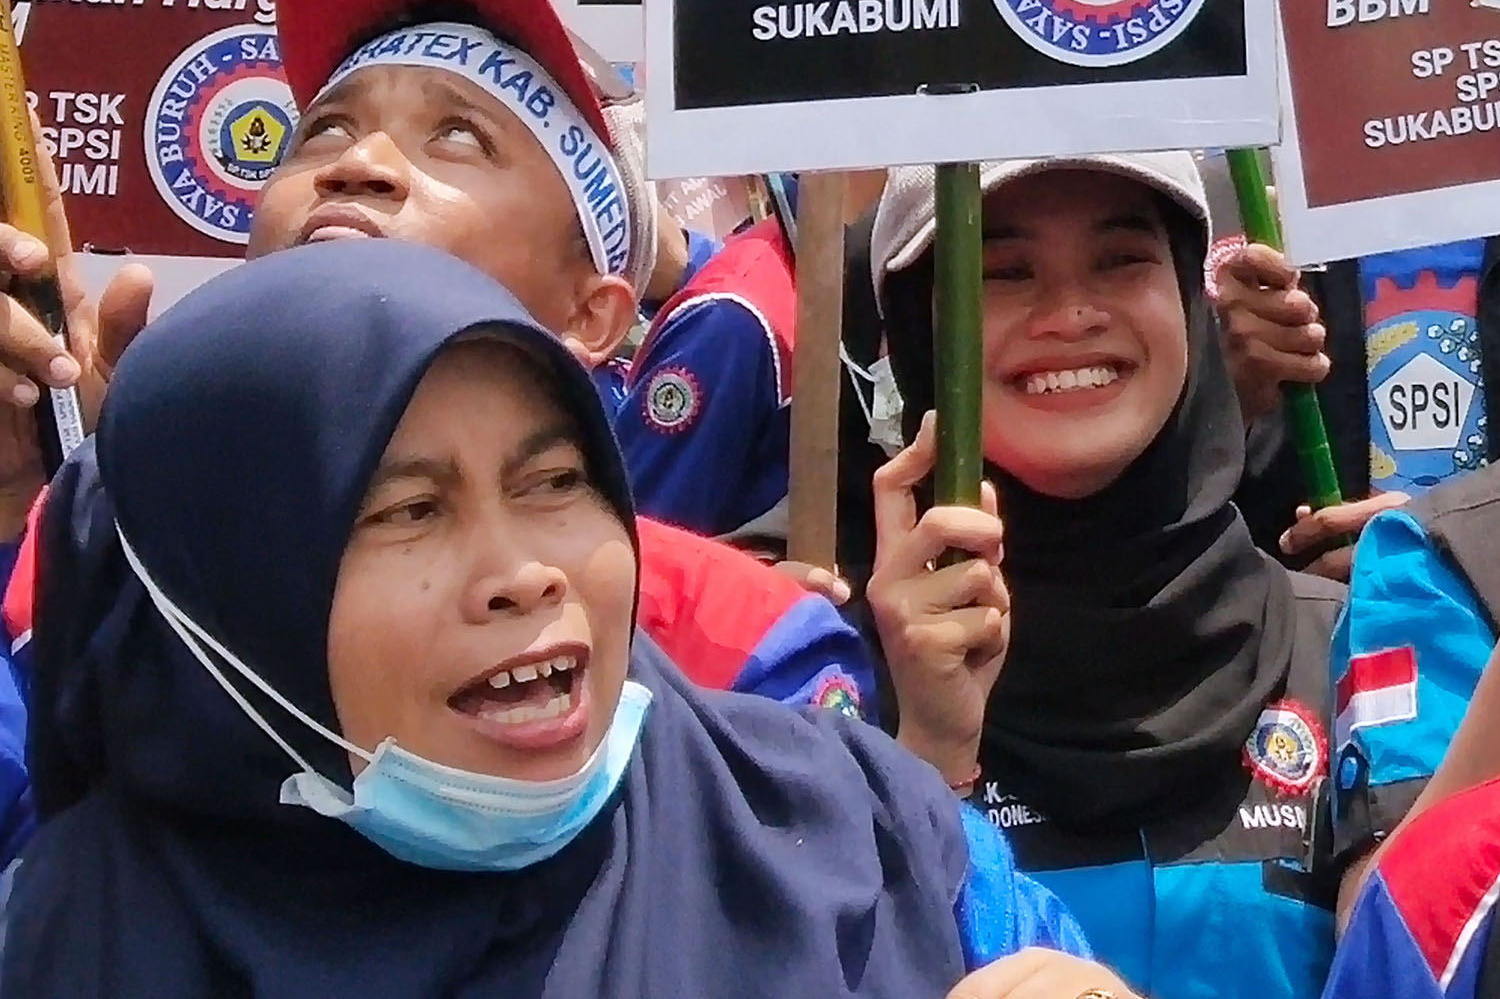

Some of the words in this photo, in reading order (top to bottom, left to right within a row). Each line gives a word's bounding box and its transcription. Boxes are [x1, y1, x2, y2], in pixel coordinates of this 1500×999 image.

[241, 37, 280, 60] SA
[1411, 47, 1454, 78] SP
[49, 91, 126, 125] TSK
[157, 52, 218, 166] BURUH
[478, 49, 555, 128] KAB.
[40, 127, 121, 160] SPSI
[173, 168, 239, 228] SAYA
[1388, 381, 1460, 431] SPSI
